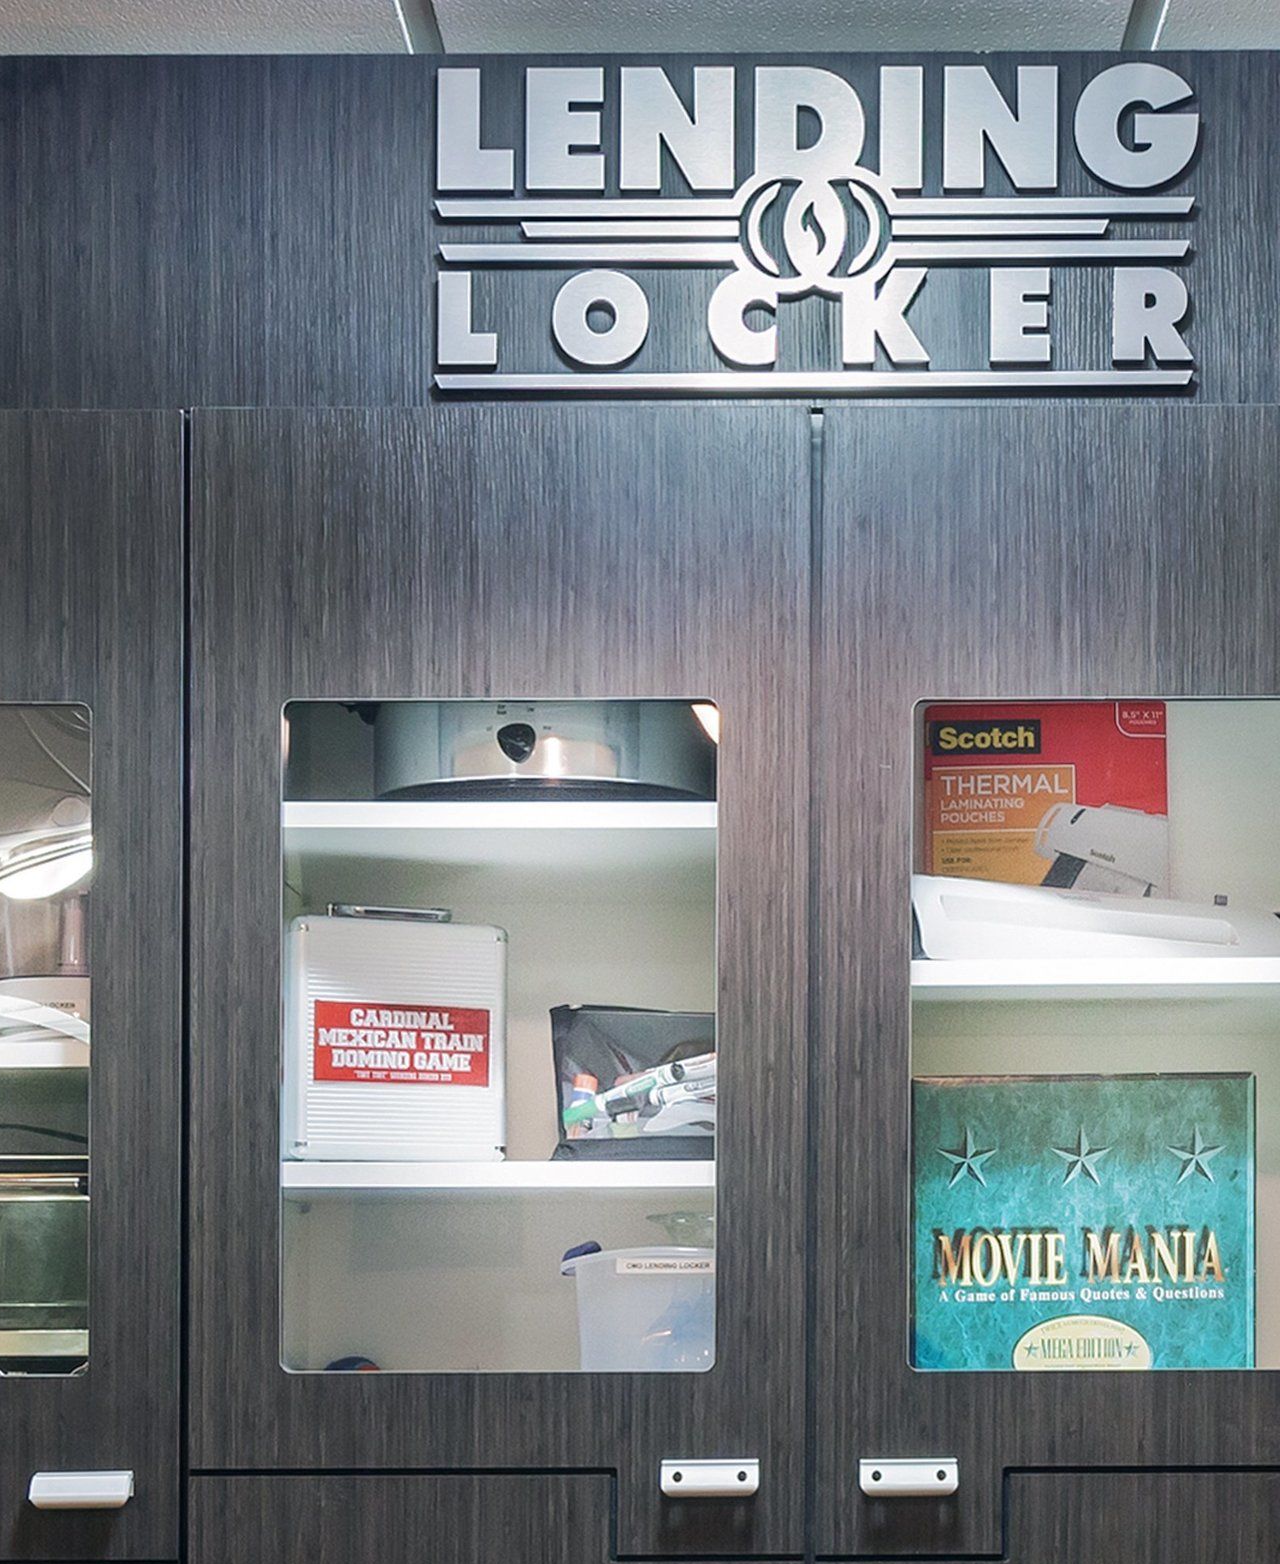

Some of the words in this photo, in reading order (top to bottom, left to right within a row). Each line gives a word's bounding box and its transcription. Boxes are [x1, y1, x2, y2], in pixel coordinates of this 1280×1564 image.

[437, 62, 1200, 190] LENDING
[437, 267, 1192, 365] LOCKER
[938, 725, 1035, 749] Scotch
[940, 772, 1069, 796] THERMAL
[940, 797, 1025, 811] LAMINATING
[940, 811, 1006, 824] POUCHES
[349, 1007, 454, 1031] CARDINAL
[317, 1028, 418, 1049] MEXICAN
[420, 1032, 486, 1052] TRAIN
[331, 1049, 411, 1070] DOMINO
[413, 1051, 472, 1072] GAME
[938, 1232, 1068, 1287] MOVIE
[1086, 1230, 1226, 1285] MANIA
[938, 1290, 949, 1303] A
[955, 1290, 996, 1303] Game
[1001, 1288, 1016, 1302] of
[1020, 1288, 1076, 1302] Famous
[1080, 1287, 1131, 1303] Quotes
[1135, 1288, 1148, 1301] &
[1152, 1285, 1225, 1302] Questions
[1076, 1337, 1123, 1358] EDITION
